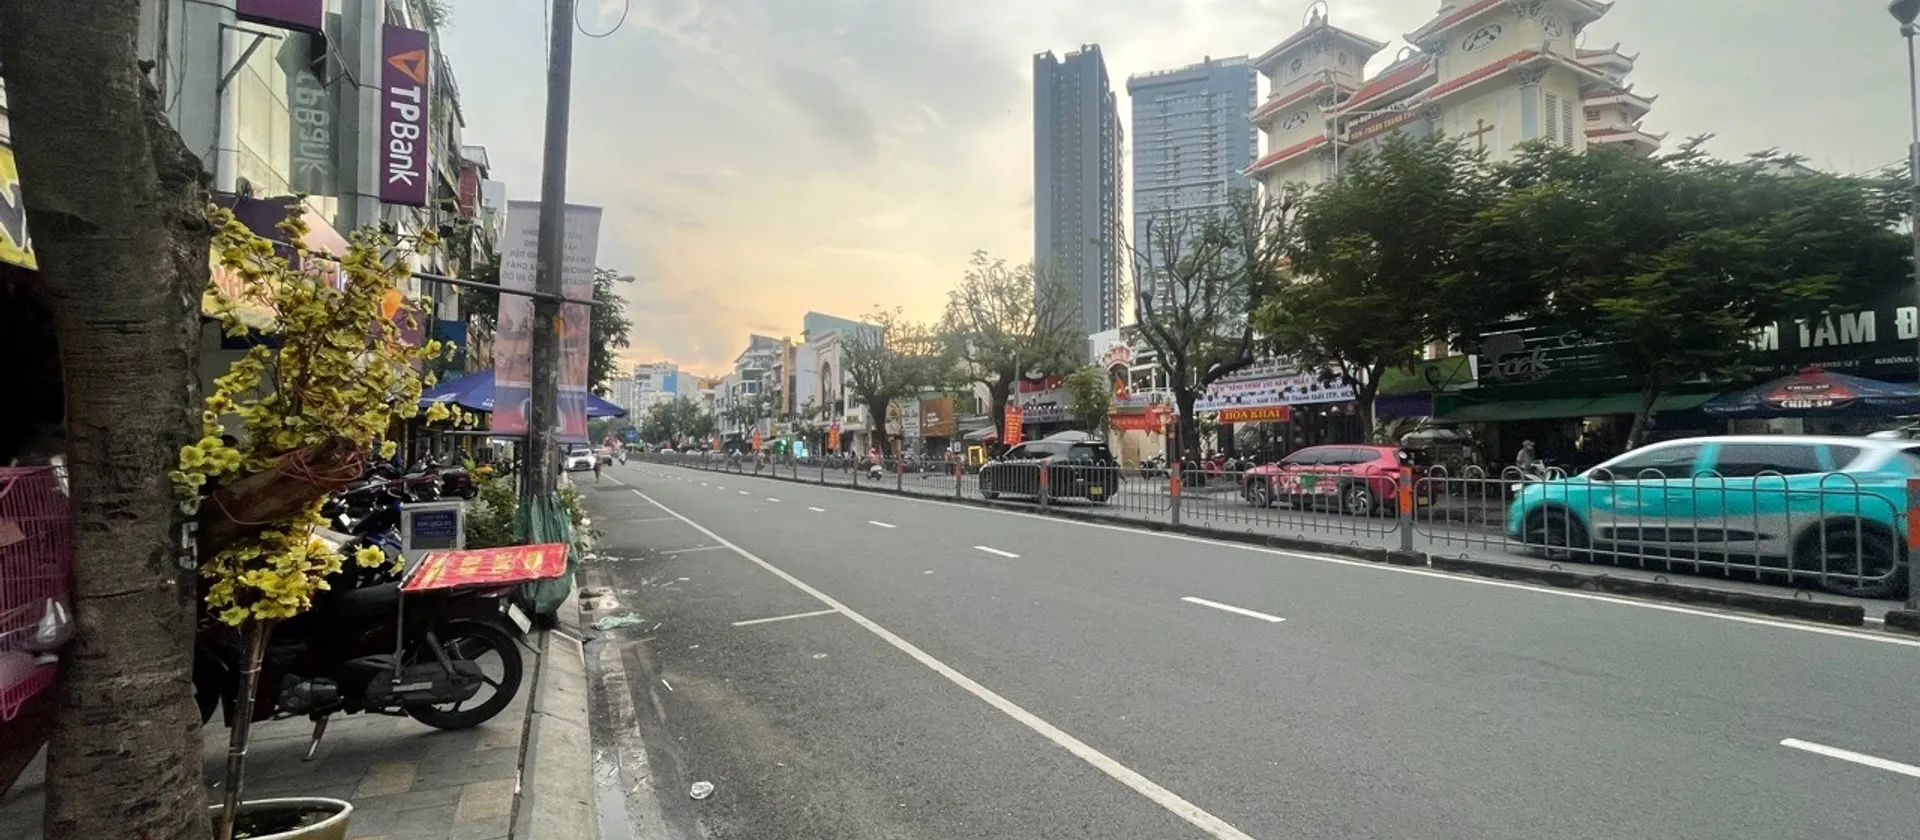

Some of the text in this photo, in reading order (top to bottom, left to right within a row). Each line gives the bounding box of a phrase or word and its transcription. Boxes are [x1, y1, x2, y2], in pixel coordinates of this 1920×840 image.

[388, 86, 421, 186] TPBank
[1225, 407, 1281, 420] HOA KHAI
